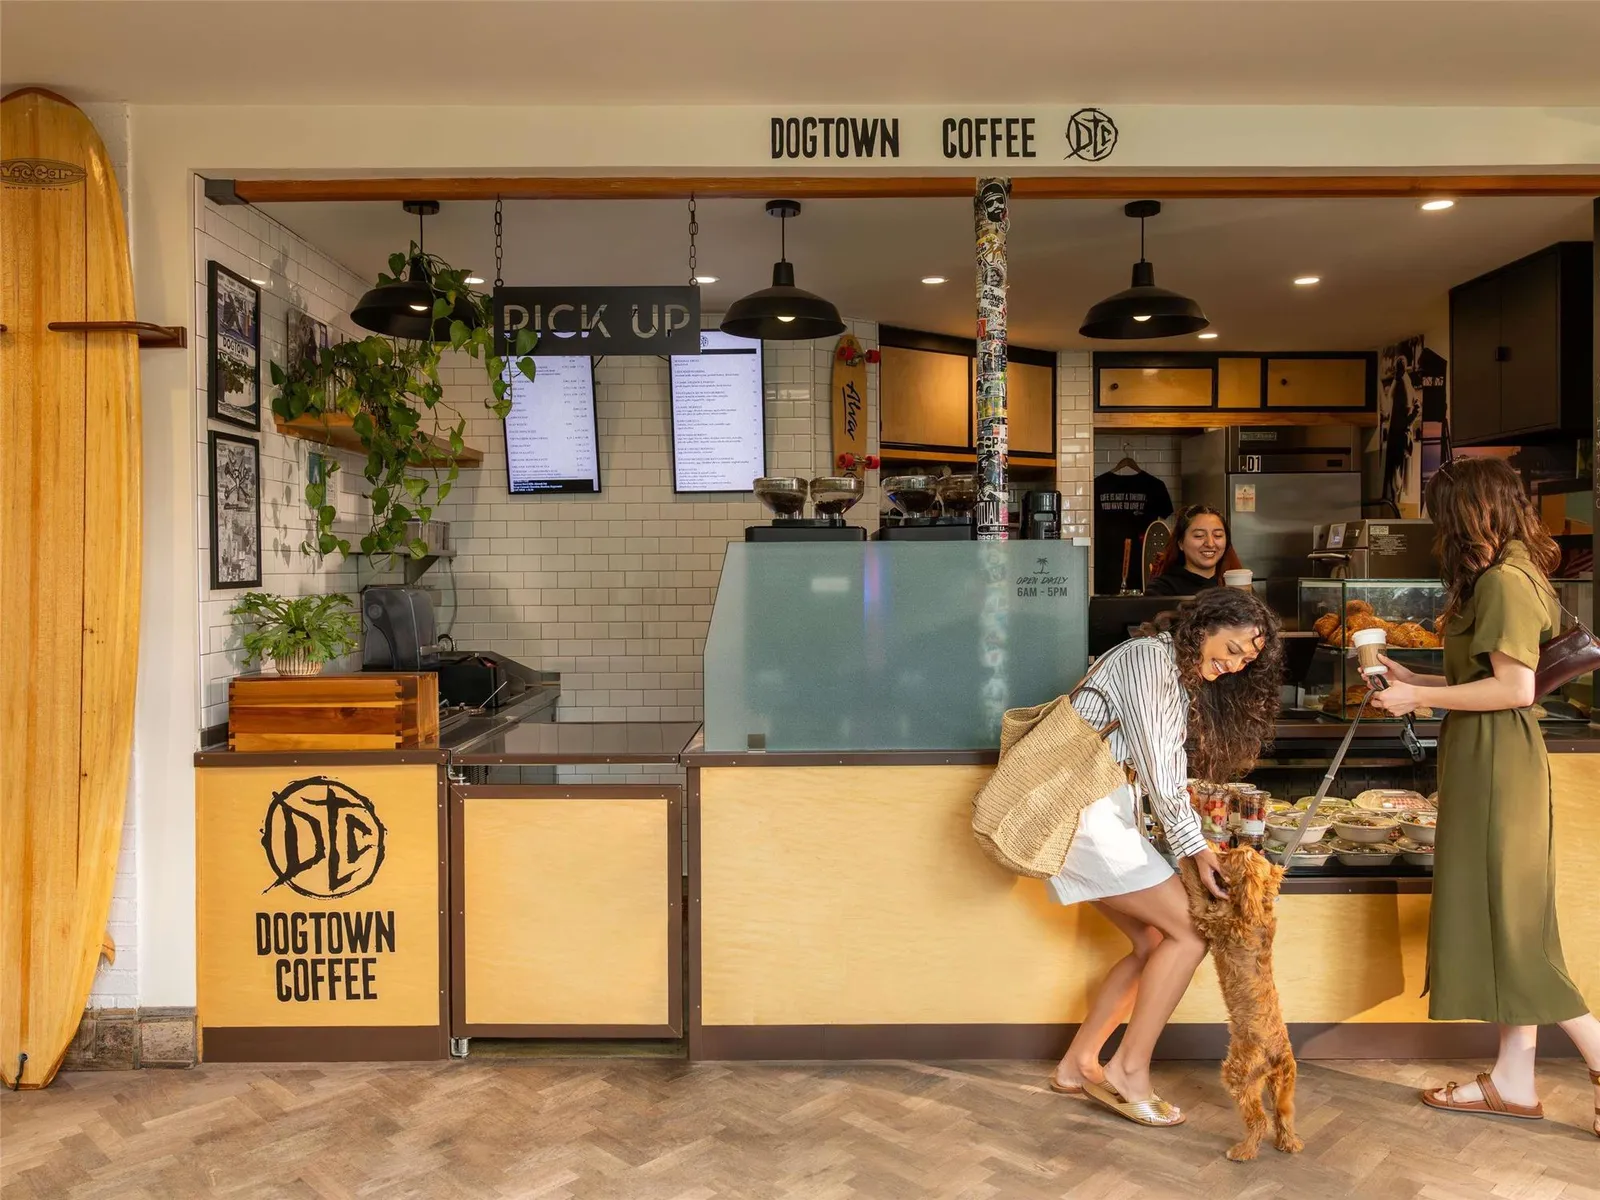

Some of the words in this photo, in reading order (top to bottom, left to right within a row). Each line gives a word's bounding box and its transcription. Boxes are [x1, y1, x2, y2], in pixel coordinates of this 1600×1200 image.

[771, 117, 900, 159] DOGTOWN
[942, 117, 1037, 159] COFFEE
[503, 304, 612, 339] PICK
[632, 304, 691, 339] UP
[222, 336, 249, 358] DOGTOWN
[1016, 577, 1039, 585] OPEN
[1041, 577, 1069, 585] DAILY
[1017, 587, 1037, 597] 6AM
[1047, 587, 1068, 597] 5PM
[255, 911, 396, 956] DOGTOWN
[276, 957, 378, 1003] COFFEE
